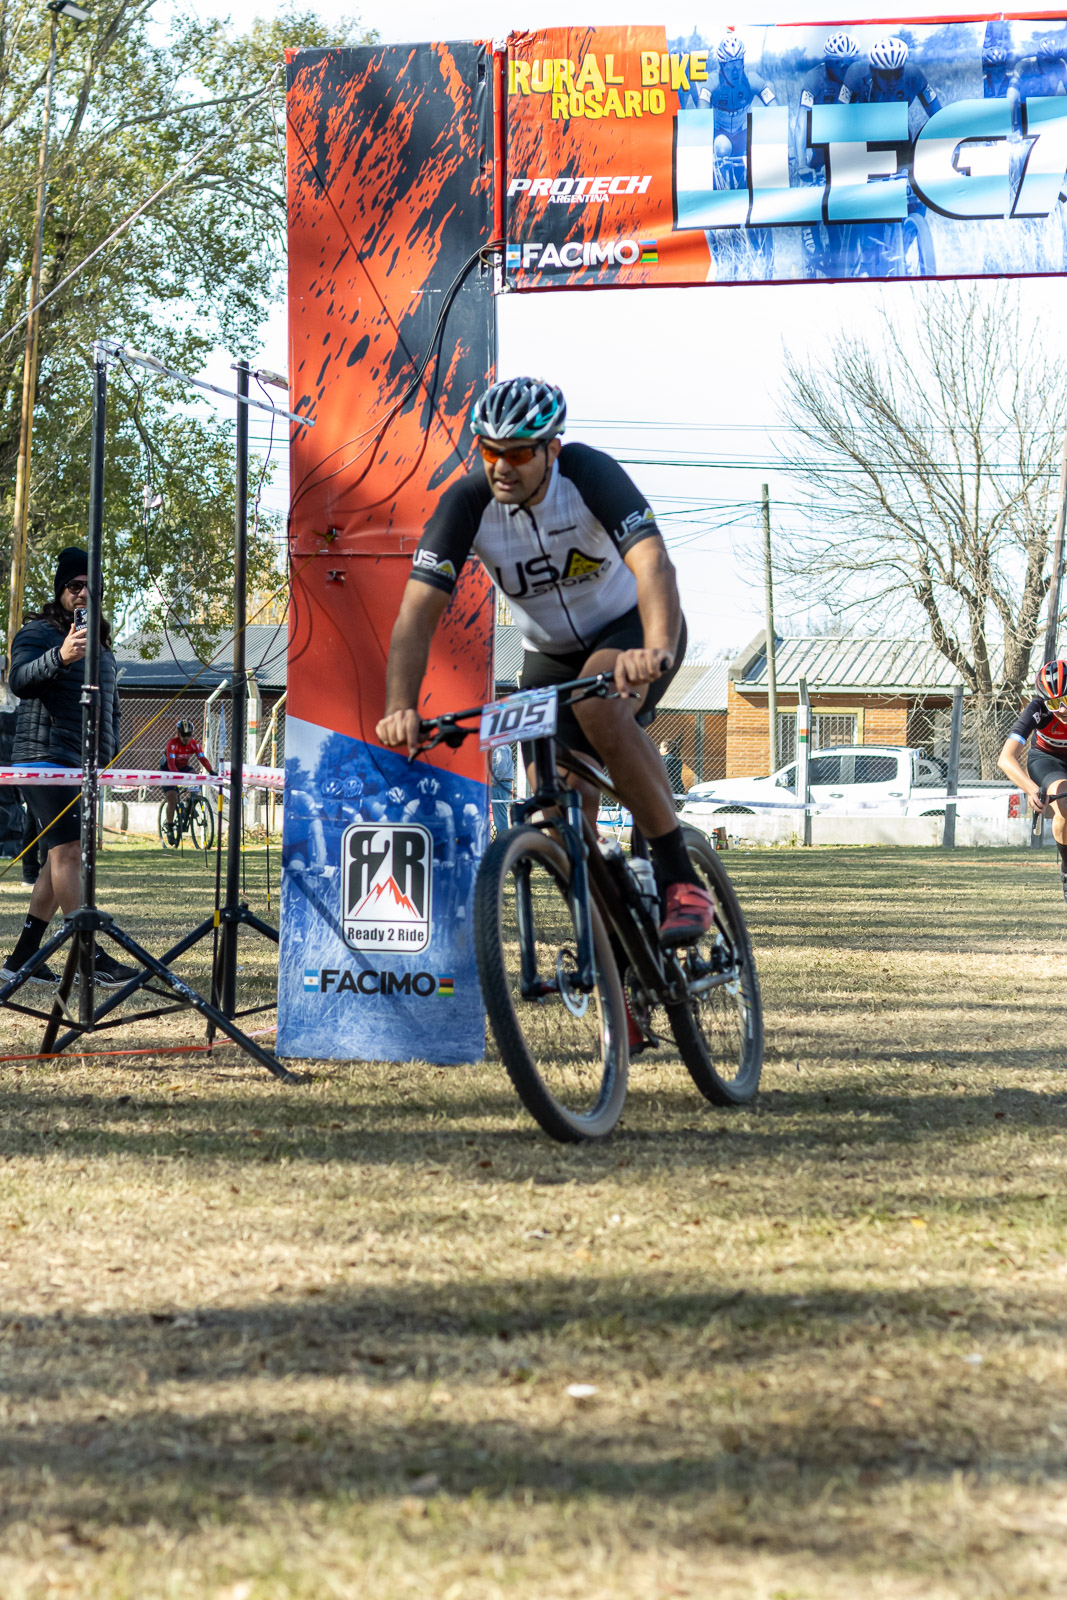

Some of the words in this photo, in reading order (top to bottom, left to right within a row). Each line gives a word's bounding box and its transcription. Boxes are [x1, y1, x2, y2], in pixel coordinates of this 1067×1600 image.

[508, 53, 625, 96] RURAL
[640, 50, 709, 92] BIKE
[551, 88, 666, 120] ROSARIO
[506, 175, 653, 197] PROTECH
[547, 193, 610, 204] ARGENTINA
[522, 239, 640, 269] FACIMO
[412, 548, 457, 579] USA
[495, 547, 607, 599] USA
[488, 700, 549, 737] 105
[347, 927, 385, 942] Ready
[387, 928, 395, 941] 2
[398, 928, 425, 942] Ride
[320, 969, 436, 997] FACIMO
